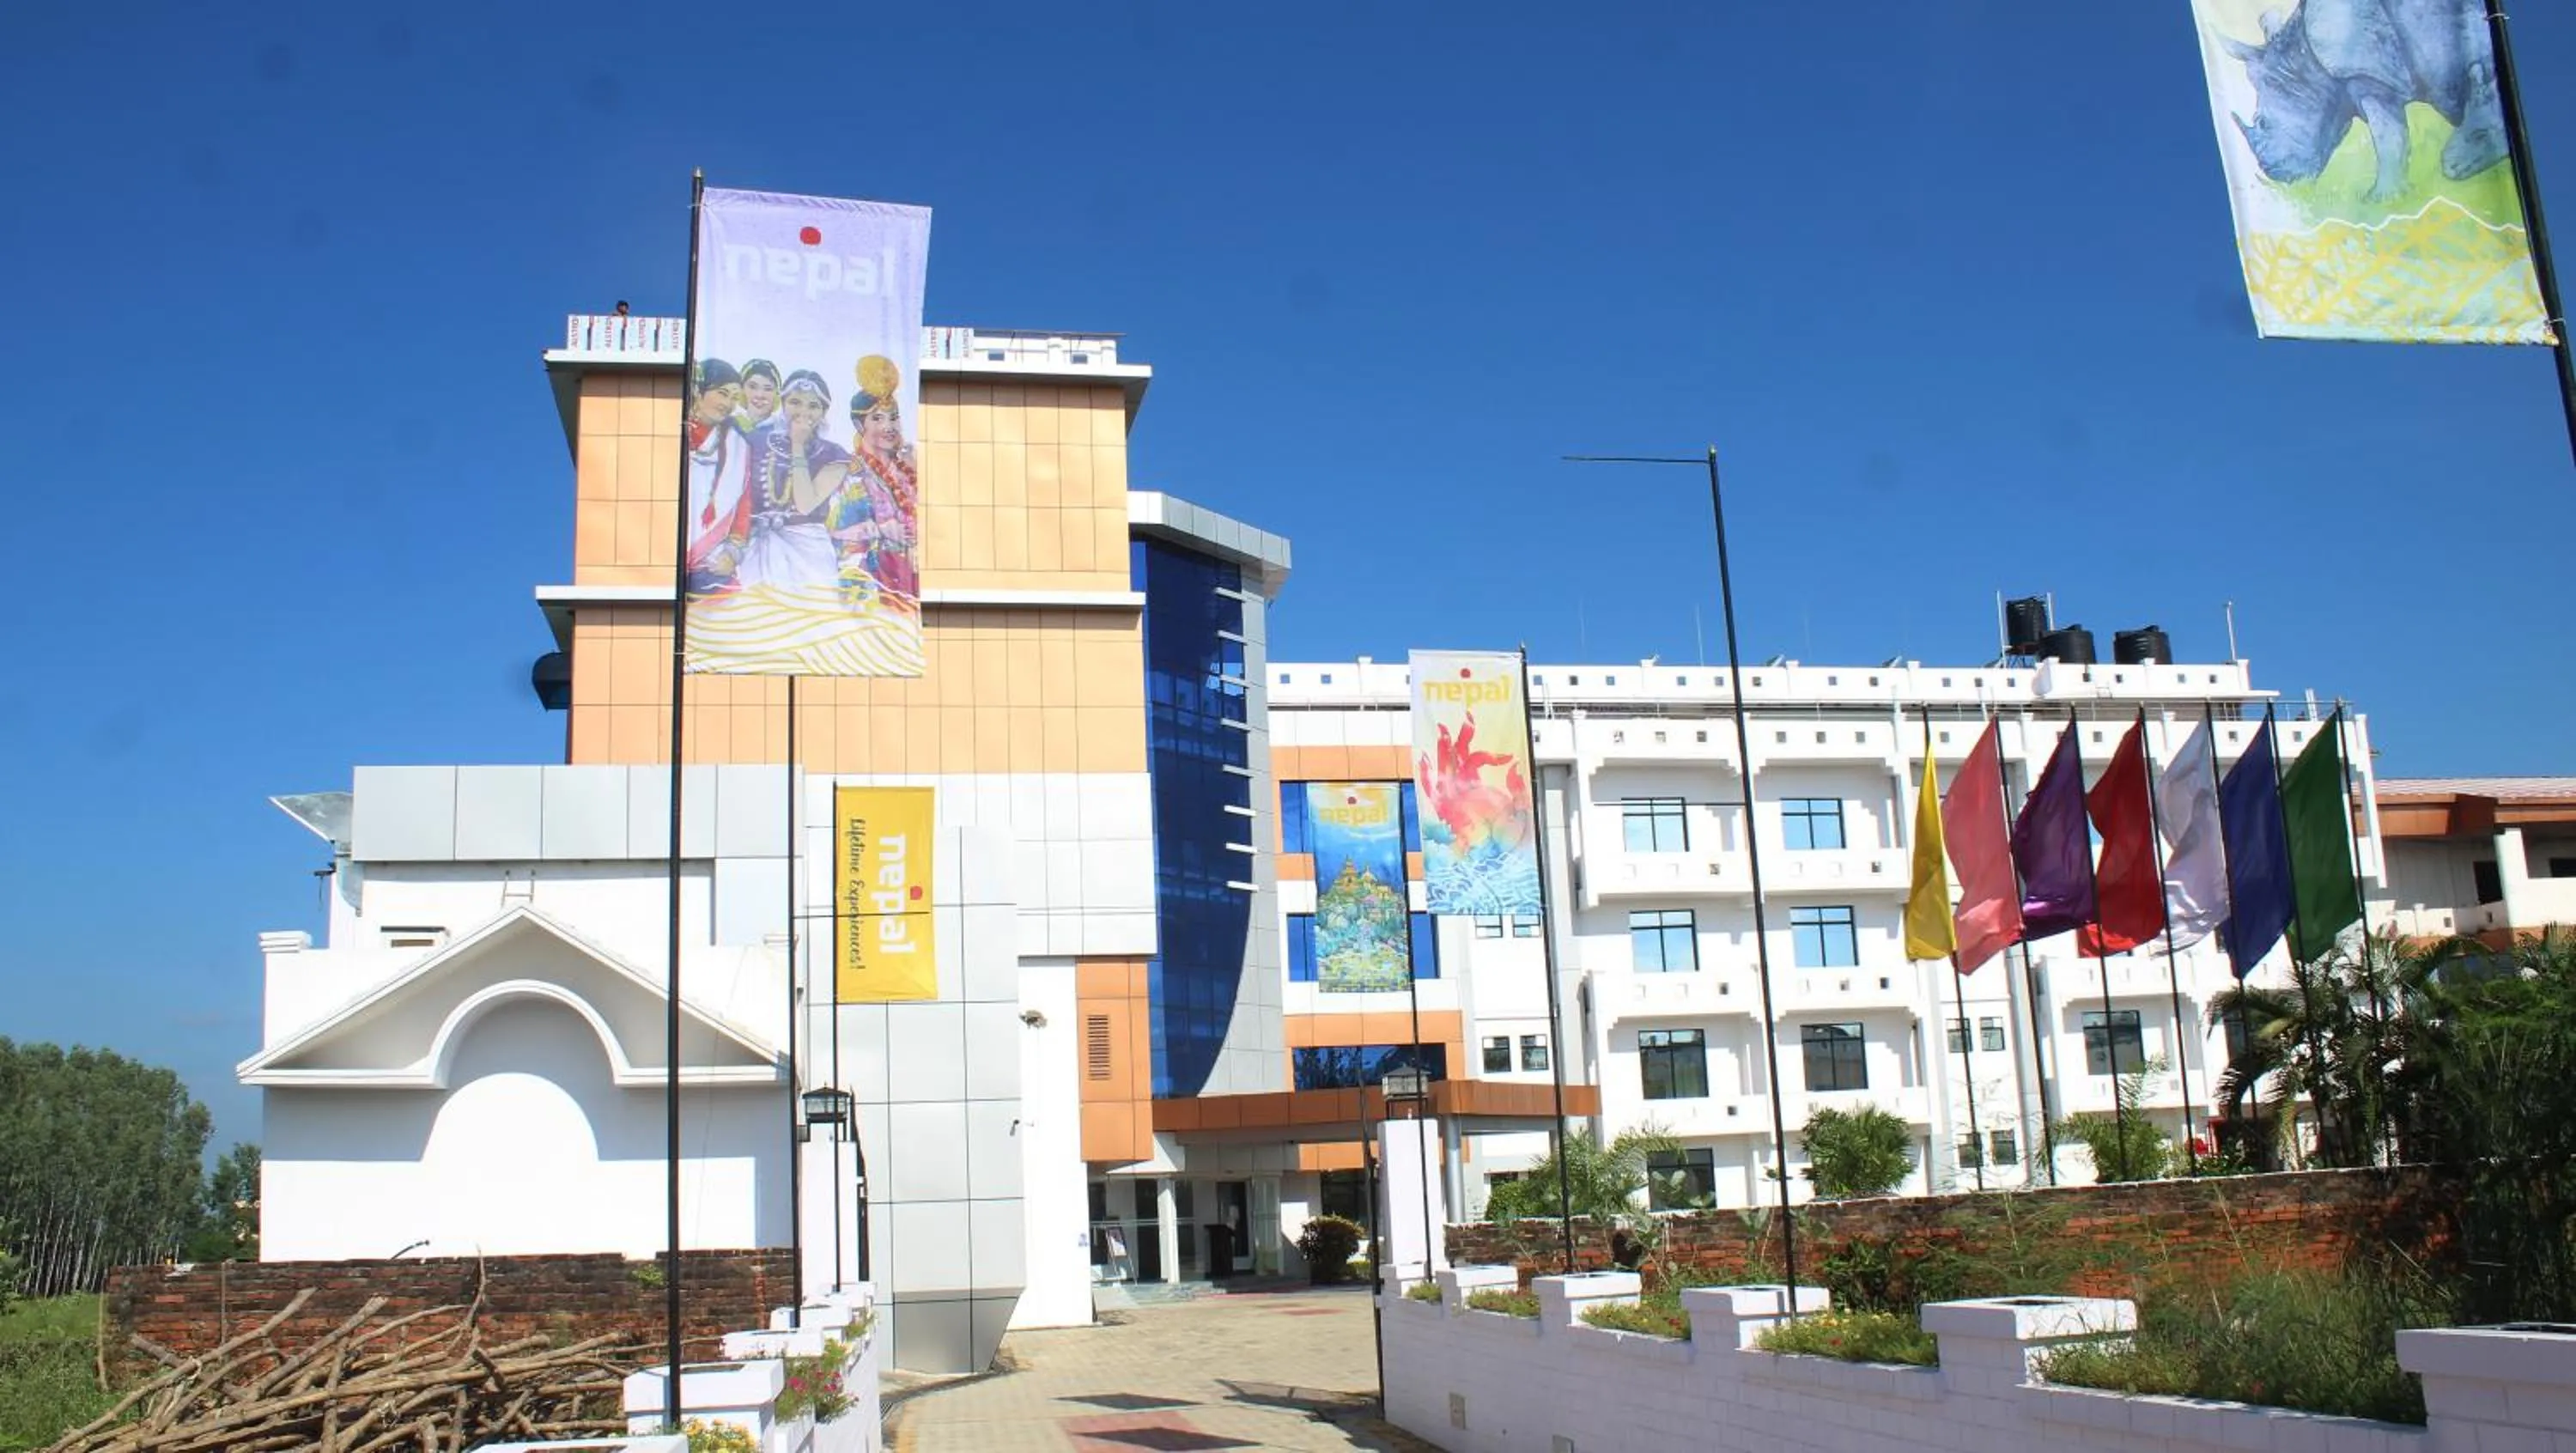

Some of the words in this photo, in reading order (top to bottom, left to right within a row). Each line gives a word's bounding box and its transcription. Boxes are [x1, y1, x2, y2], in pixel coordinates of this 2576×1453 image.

[724, 243, 896, 301] nepal
[1422, 674, 1511, 709] nepal
[1319, 803, 1388, 827] nepal
[845, 818, 866, 873] Lifetime
[871, 832, 916, 953] nepal
